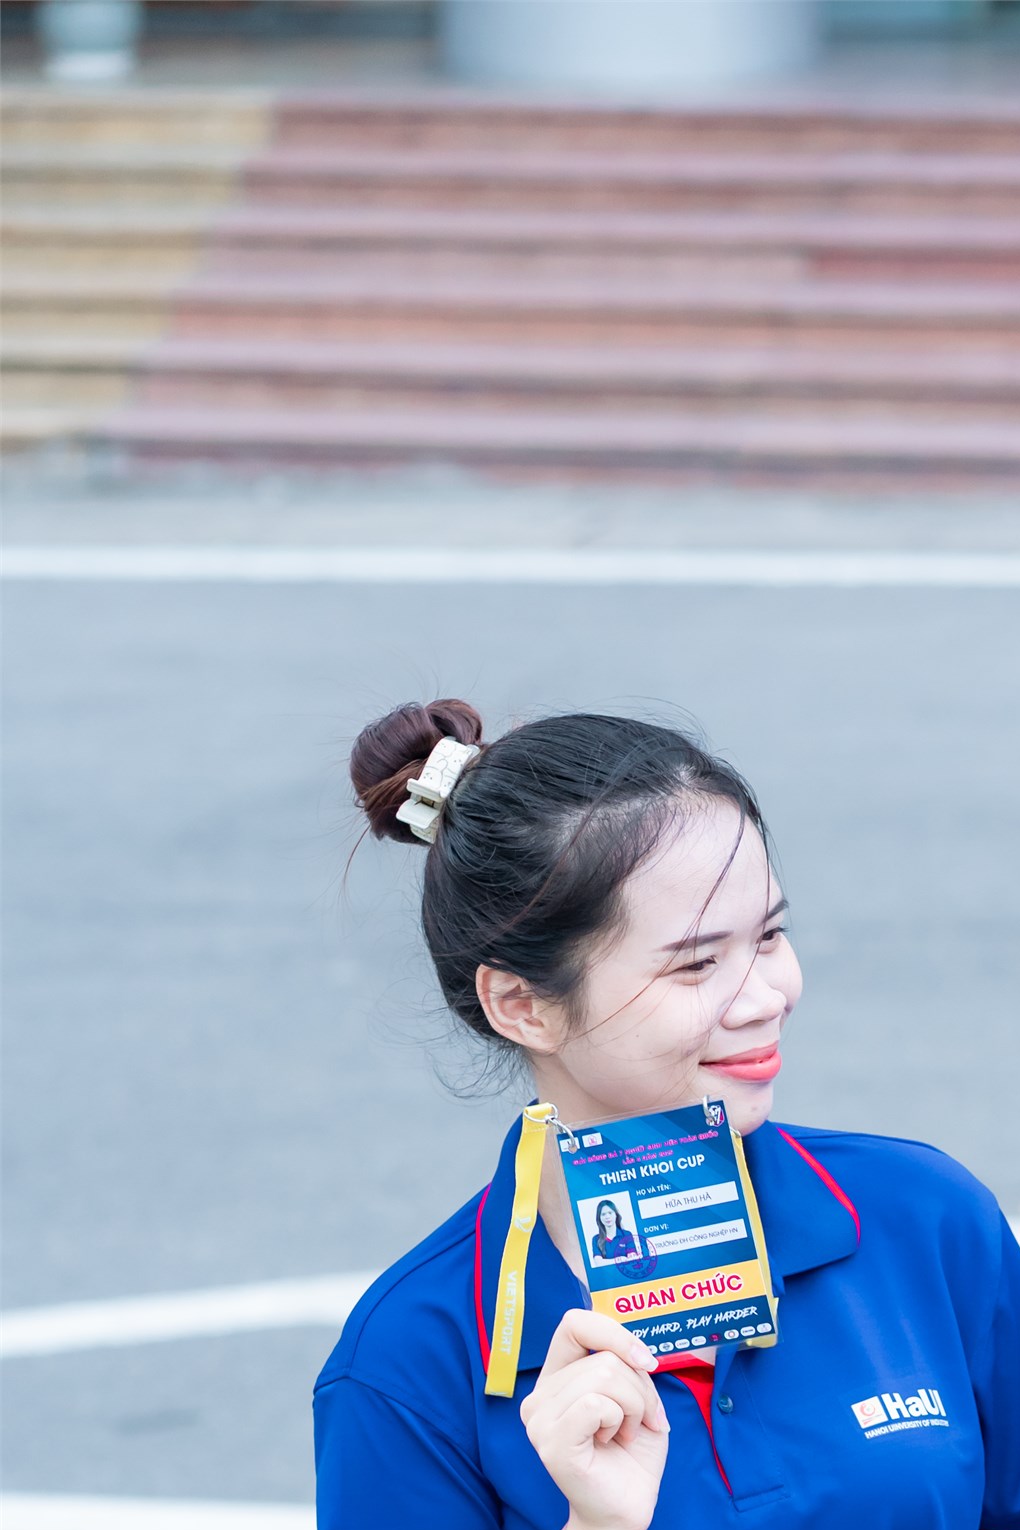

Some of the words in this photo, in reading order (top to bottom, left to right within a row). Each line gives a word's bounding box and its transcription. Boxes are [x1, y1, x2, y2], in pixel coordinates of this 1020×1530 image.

[639, 1159, 673, 1178] KHOI
[676, 1152, 706, 1170] CUP
[635, 1188, 646, 1196] HỌ
[646, 1185, 656, 1193] VÀ
[683, 1195, 698, 1205] THU
[698, 1191, 711, 1201] HÀ
[643, 1224, 659, 1233] ĐƠN
[614, 1287, 676, 1314] QUAN
[680, 1272, 744, 1302] CHỨC
[649, 1320, 682, 1337] HARD,
[685, 1314, 713, 1329] PLAY
[713, 1305, 758, 1324] HARDER
[864, 1427, 888, 1440] HANOI
